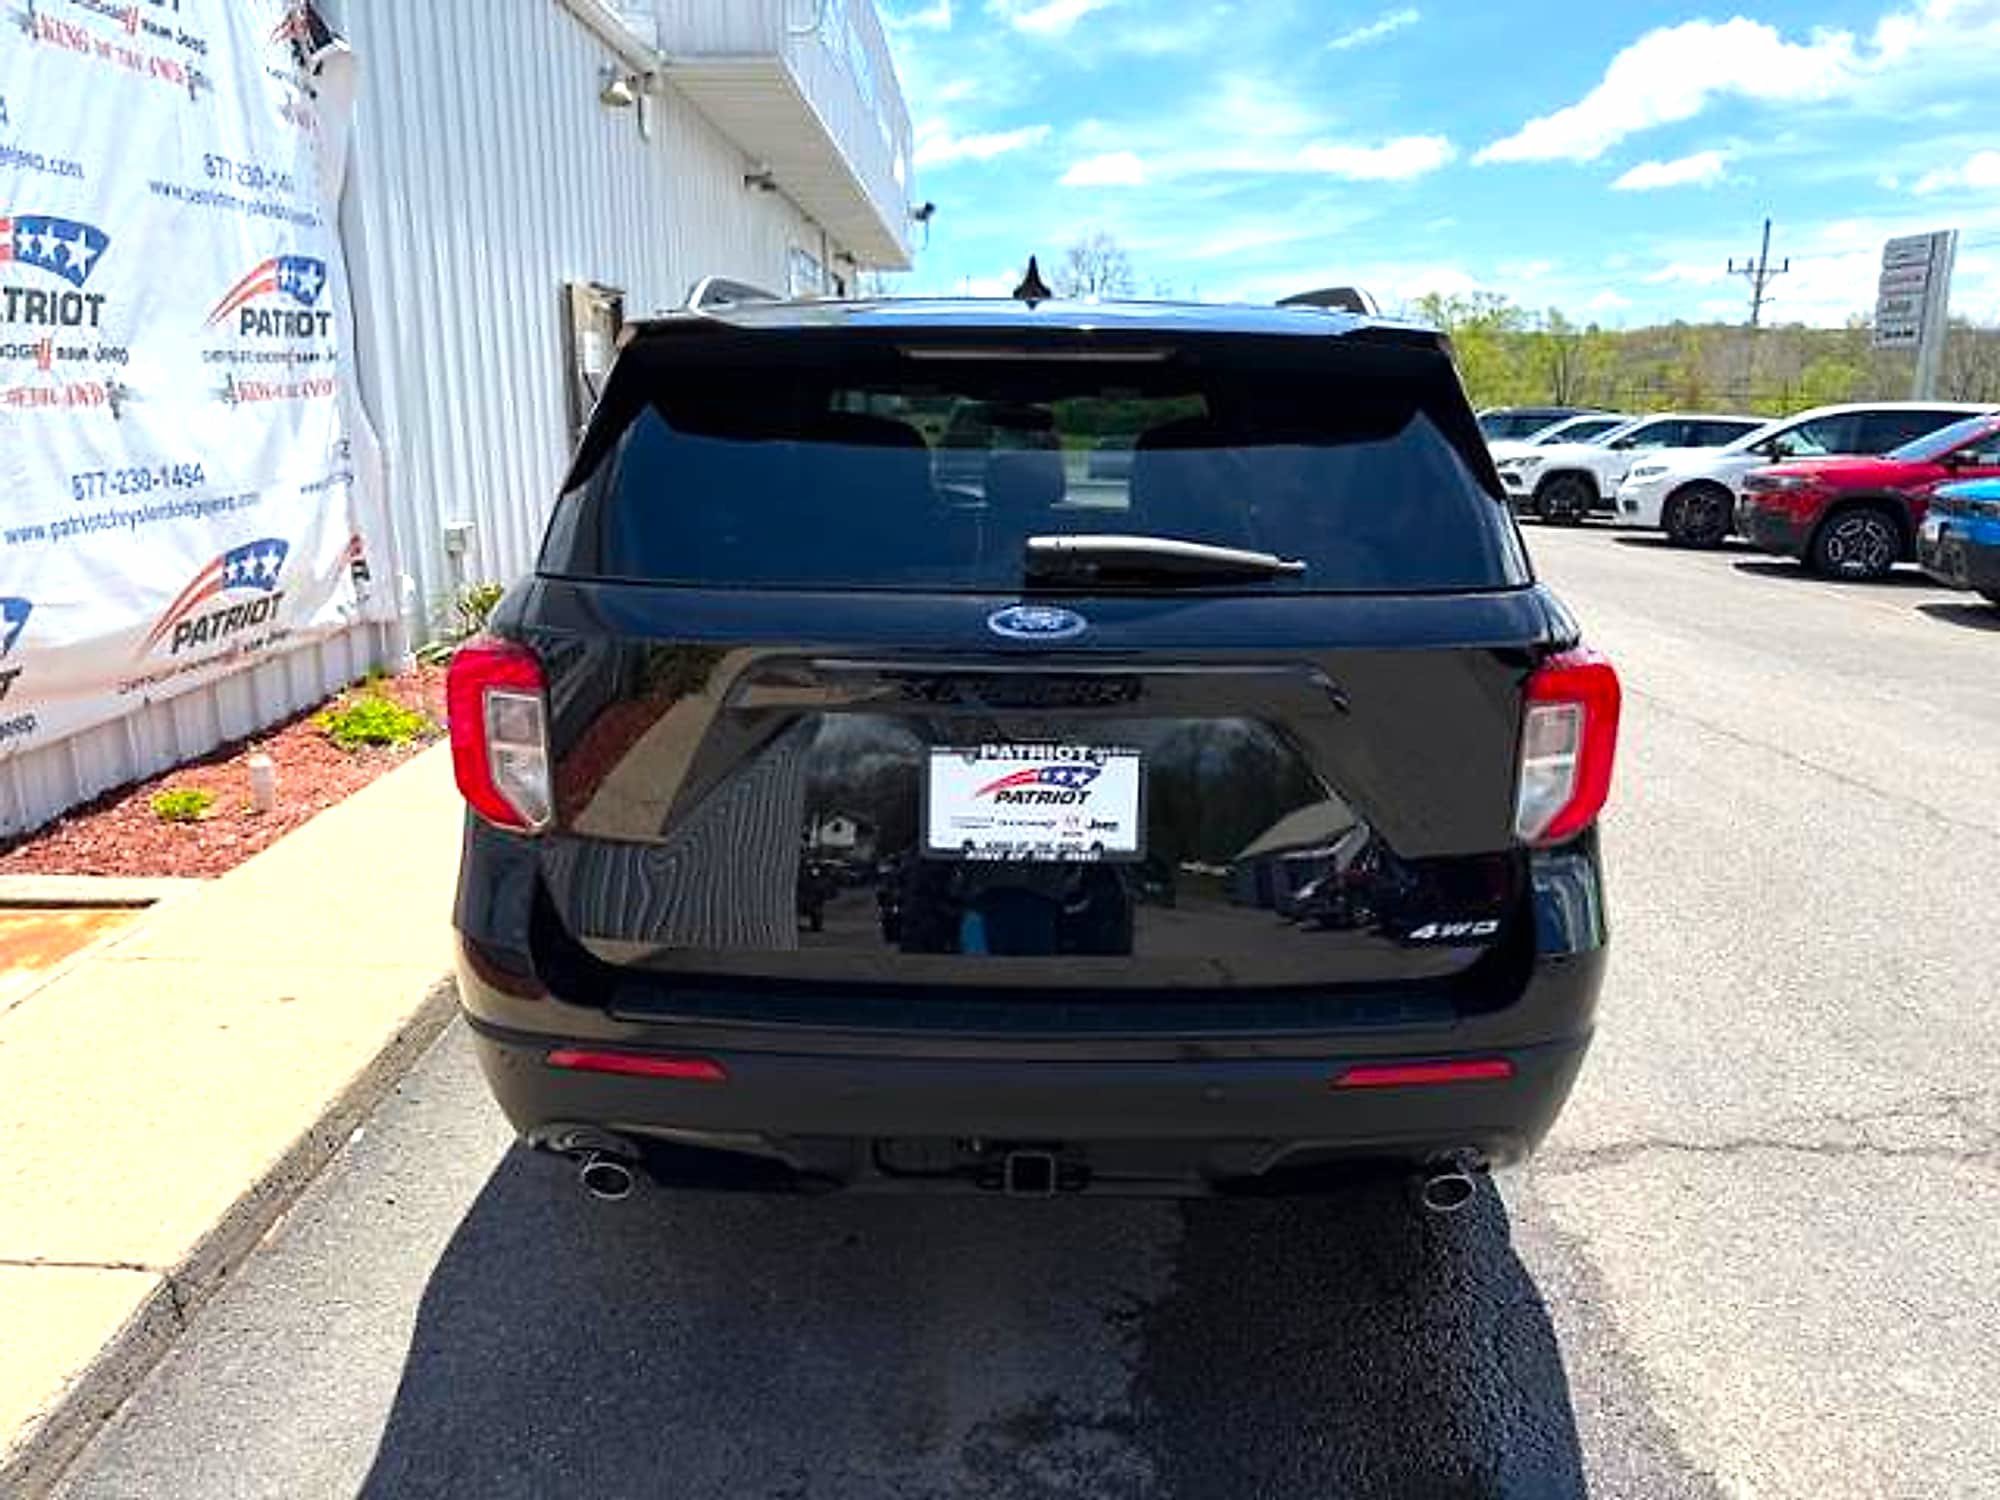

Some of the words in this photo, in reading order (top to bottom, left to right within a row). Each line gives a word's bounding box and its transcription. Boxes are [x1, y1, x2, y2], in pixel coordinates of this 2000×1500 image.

[0, 285, 106, 328] TRIOT
[171, 591, 284, 654] PATRIOT
[980, 744, 1086, 761] PATRIOT
[994, 790, 1092, 805] PATRIOT
[1409, 920, 1499, 939] 4WD
